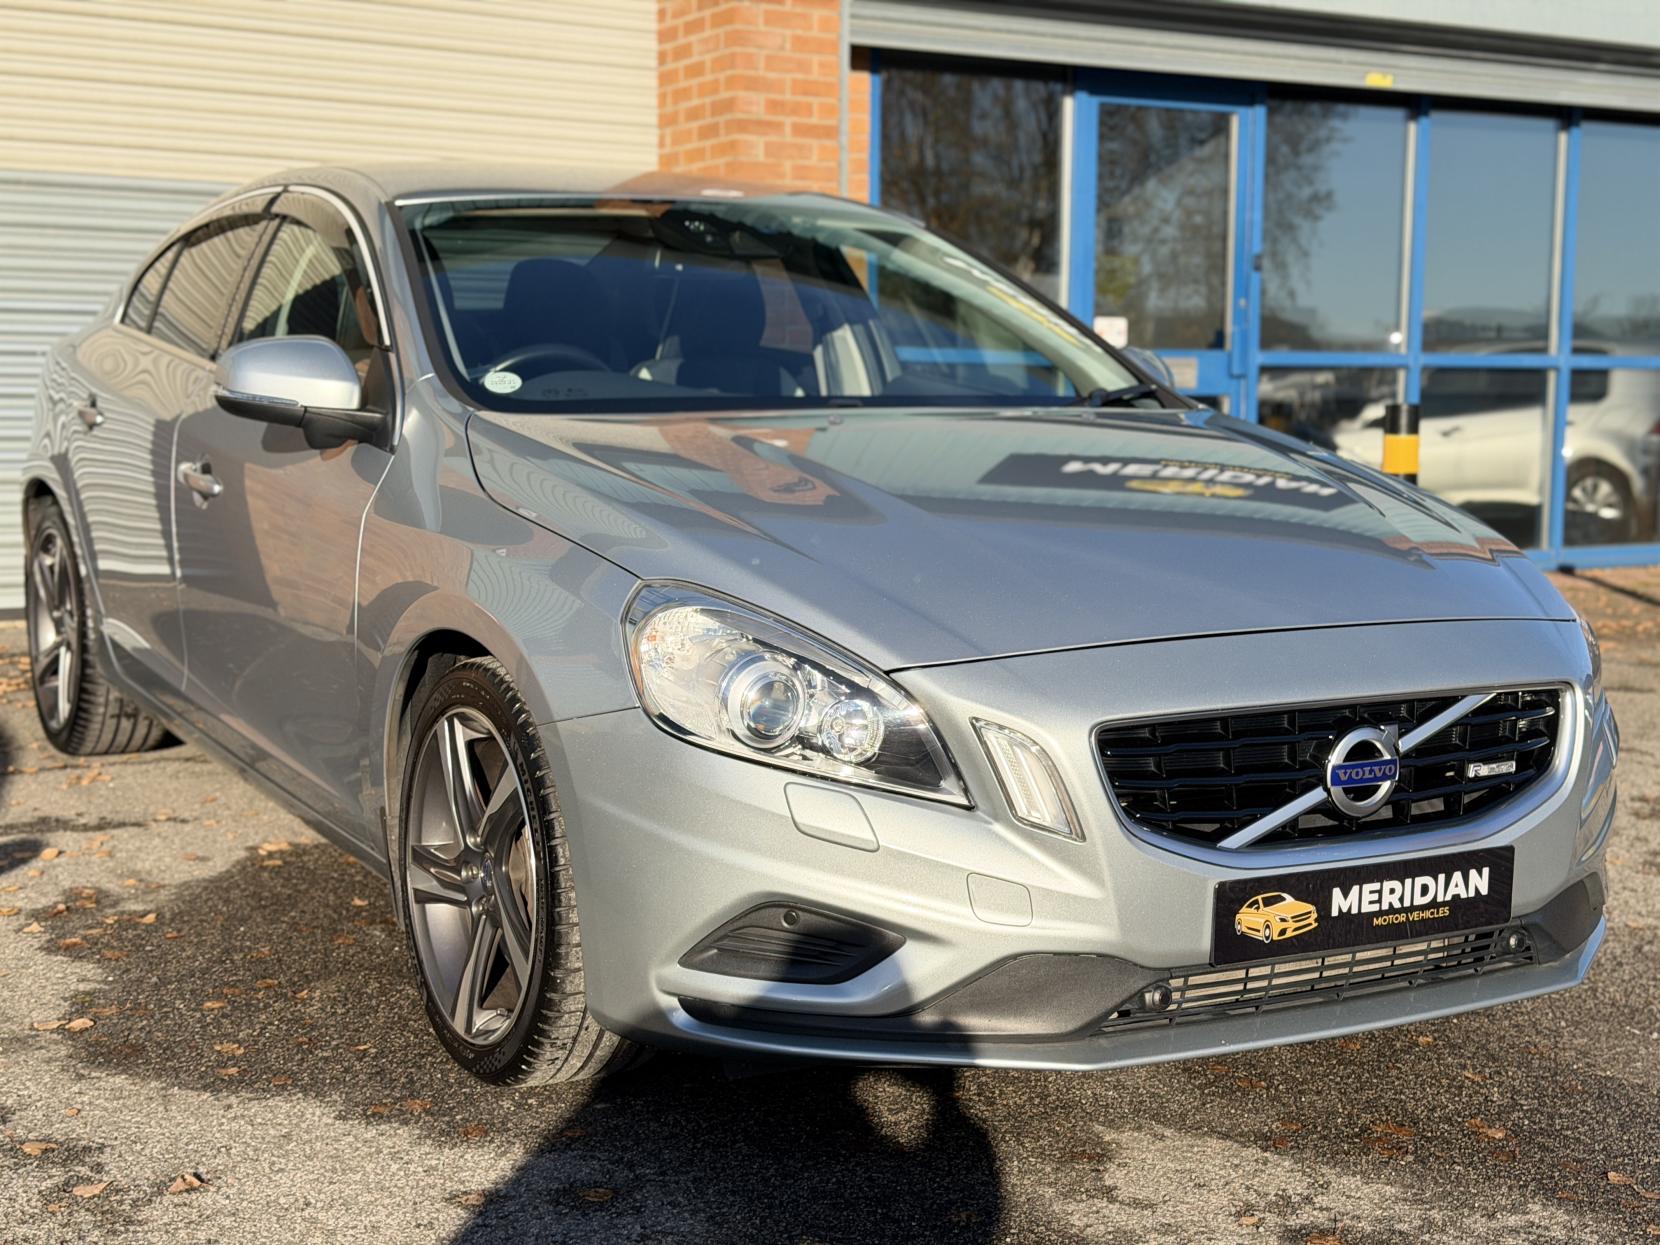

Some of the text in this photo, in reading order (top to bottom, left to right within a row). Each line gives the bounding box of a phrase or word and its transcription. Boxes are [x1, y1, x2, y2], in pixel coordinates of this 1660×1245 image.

[1335, 763, 1397, 781] VOLVO
[1330, 866, 1491, 918] MERIDIAN
[1372, 906, 1451, 928] MOTOR VEHICLES
